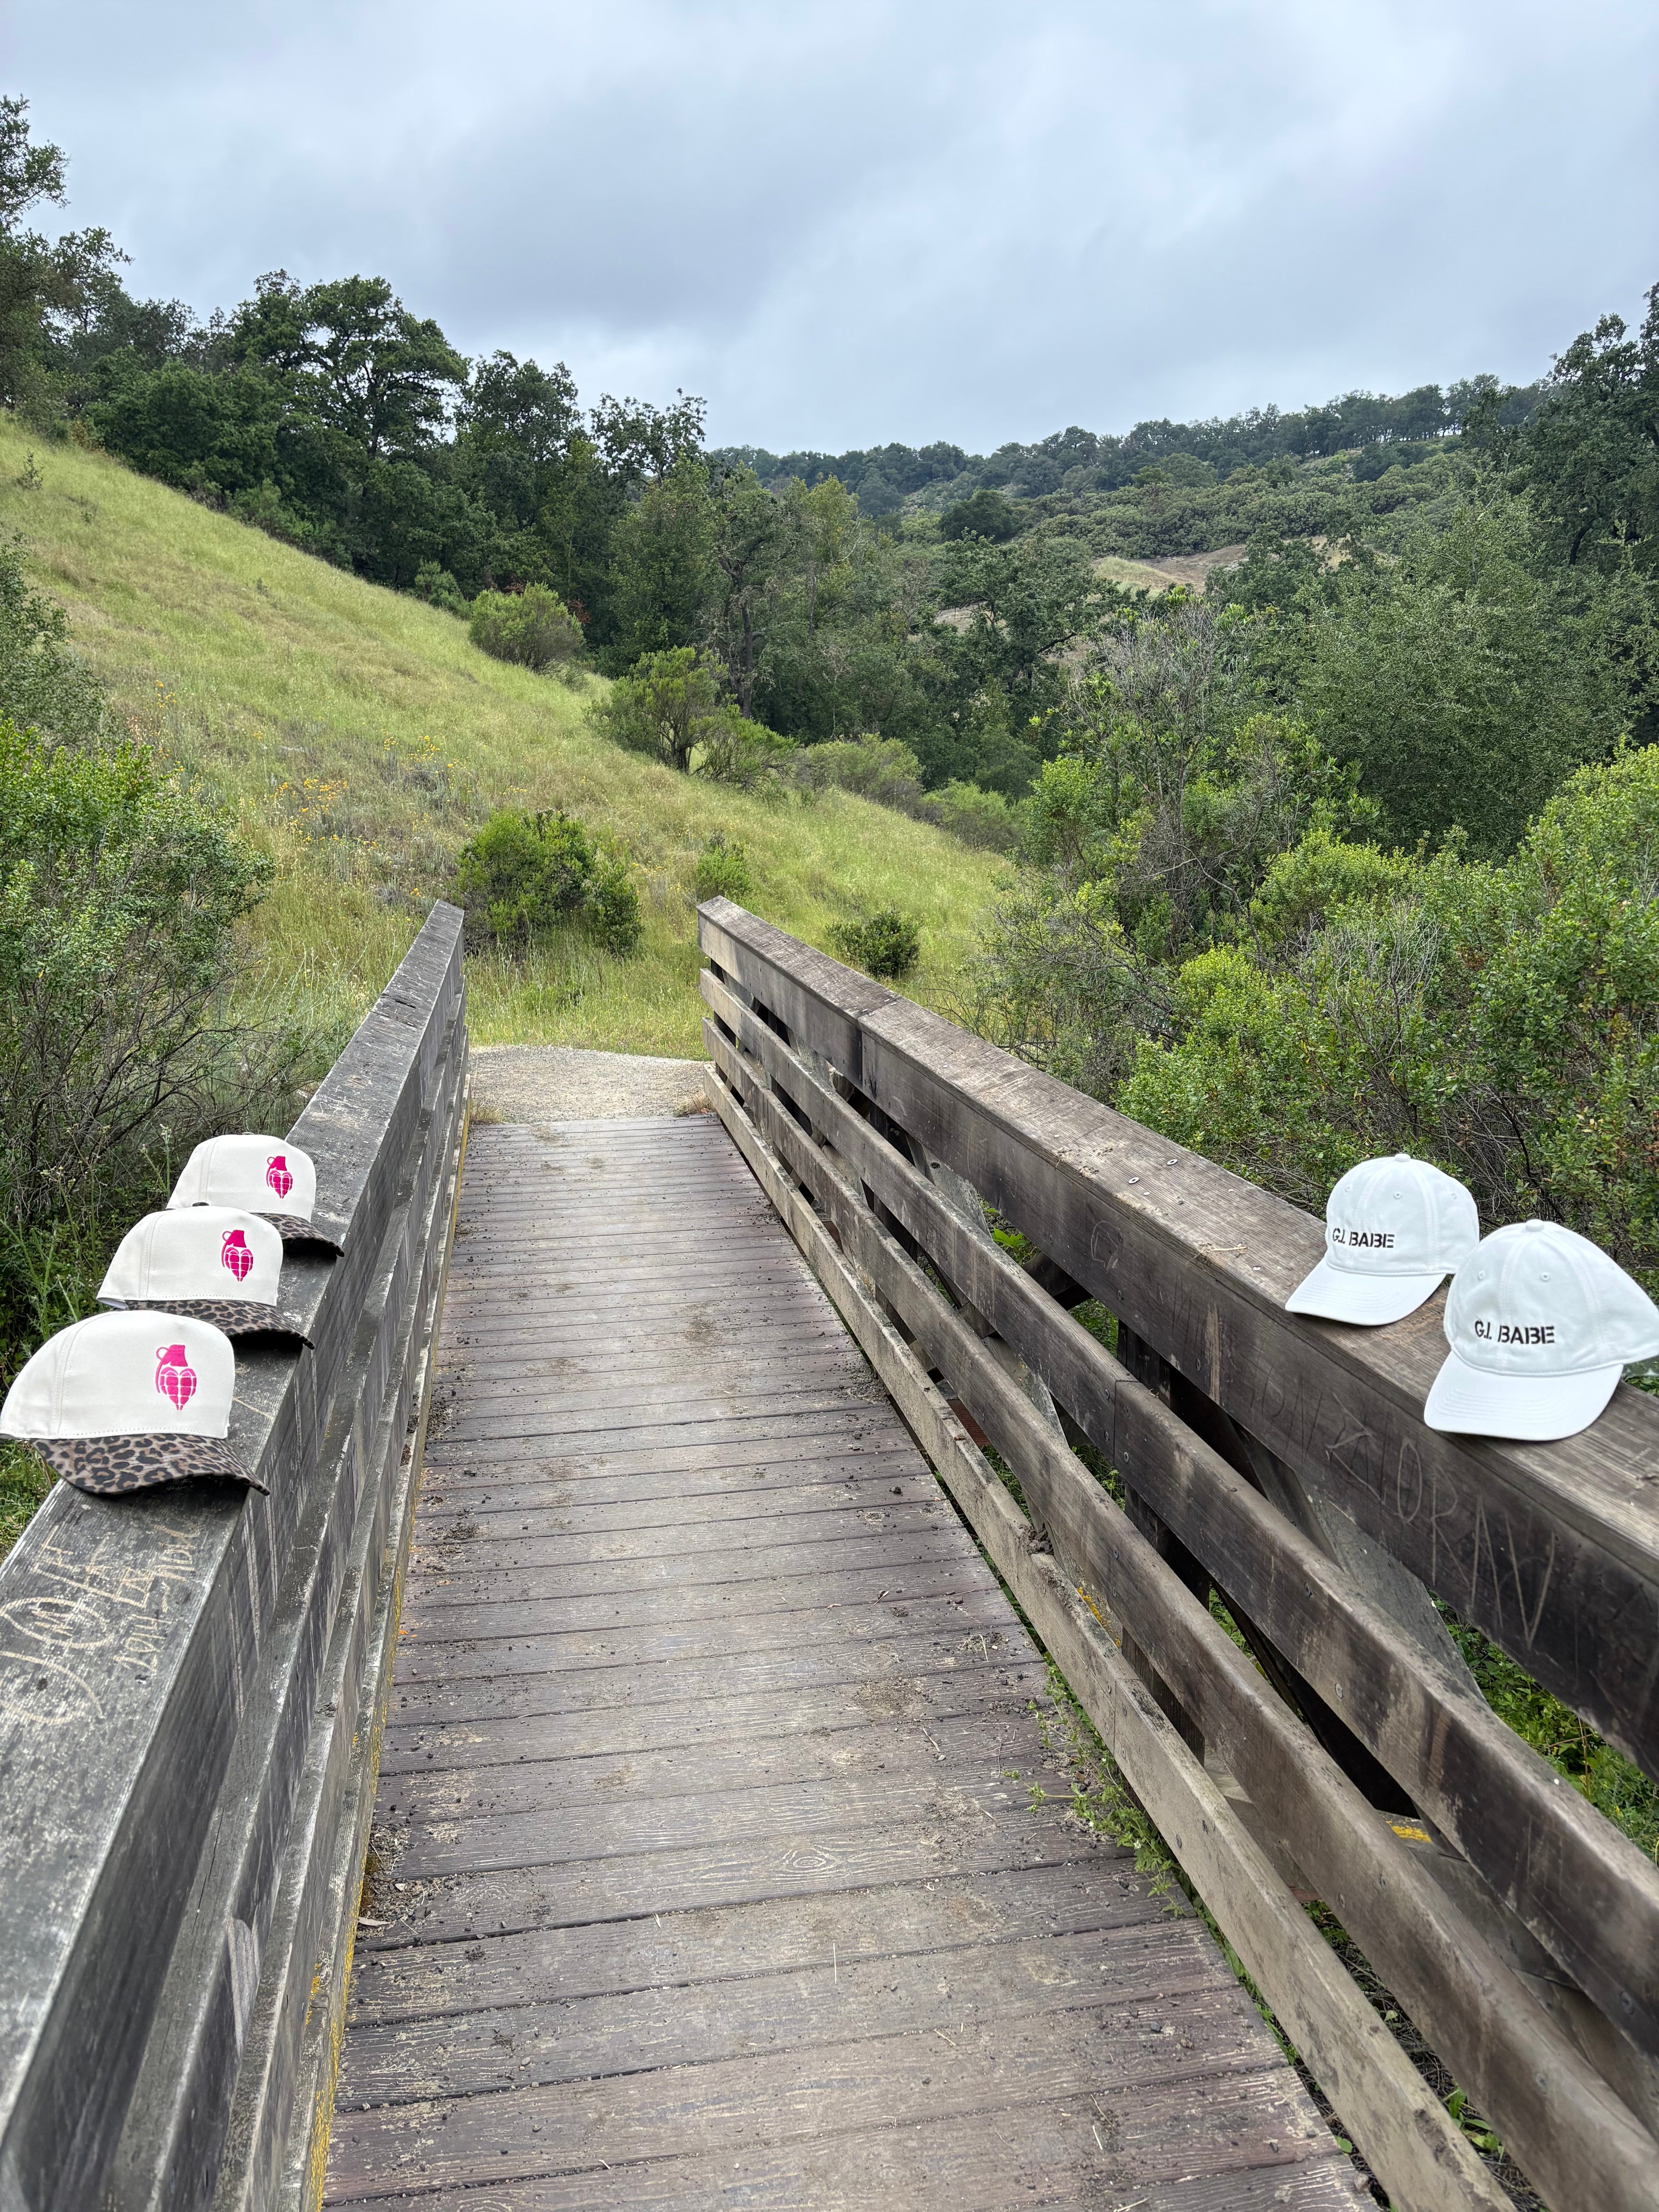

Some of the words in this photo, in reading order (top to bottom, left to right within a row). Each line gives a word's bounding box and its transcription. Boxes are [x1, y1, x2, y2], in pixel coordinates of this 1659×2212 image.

[1349, 1231, 1395, 1248] BABE
[1475, 1320, 1492, 1340] G.I.
[1497, 1325, 1555, 1344] BABE
